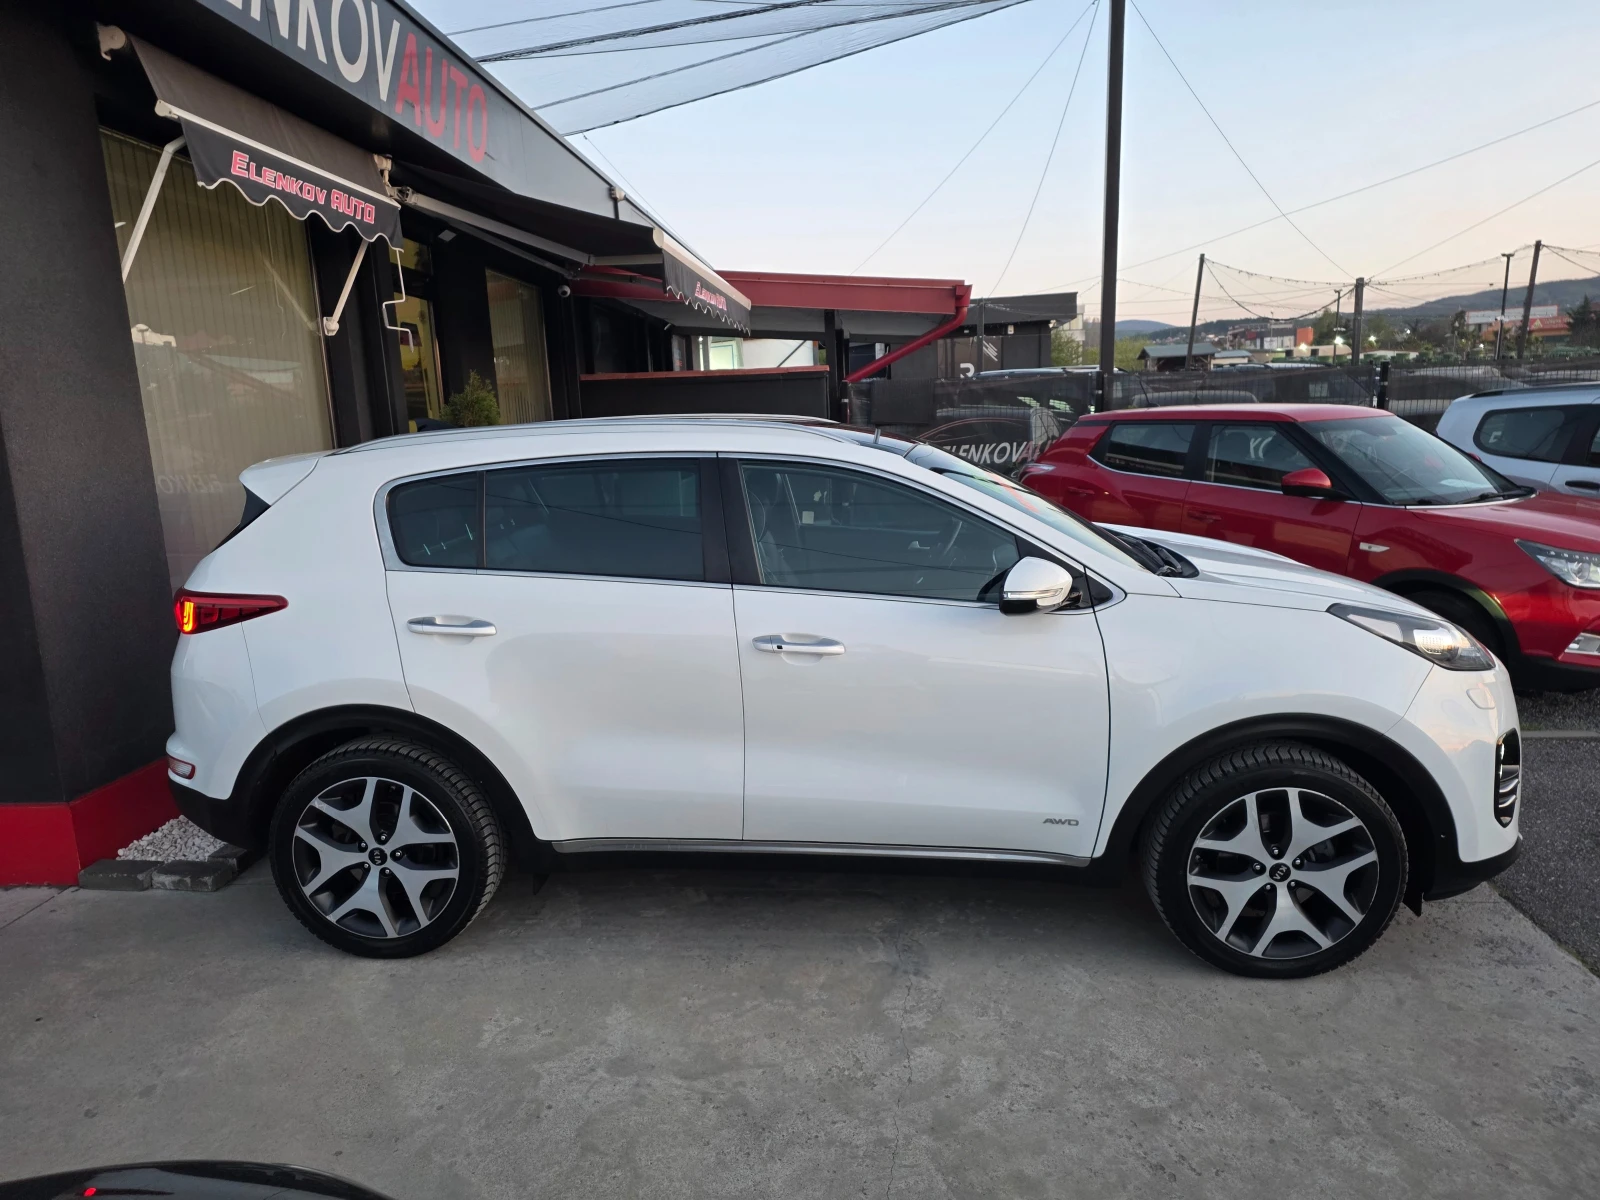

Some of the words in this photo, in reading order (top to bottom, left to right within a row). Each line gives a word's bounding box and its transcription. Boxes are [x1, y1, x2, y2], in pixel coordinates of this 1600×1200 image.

[395, 32, 487, 163] AUTO
[231, 150, 327, 205] ELENKOV
[331, 189, 376, 224] AUTO
[1042, 818, 1080, 826] AWD
[1273, 865, 1288, 880] KIA
